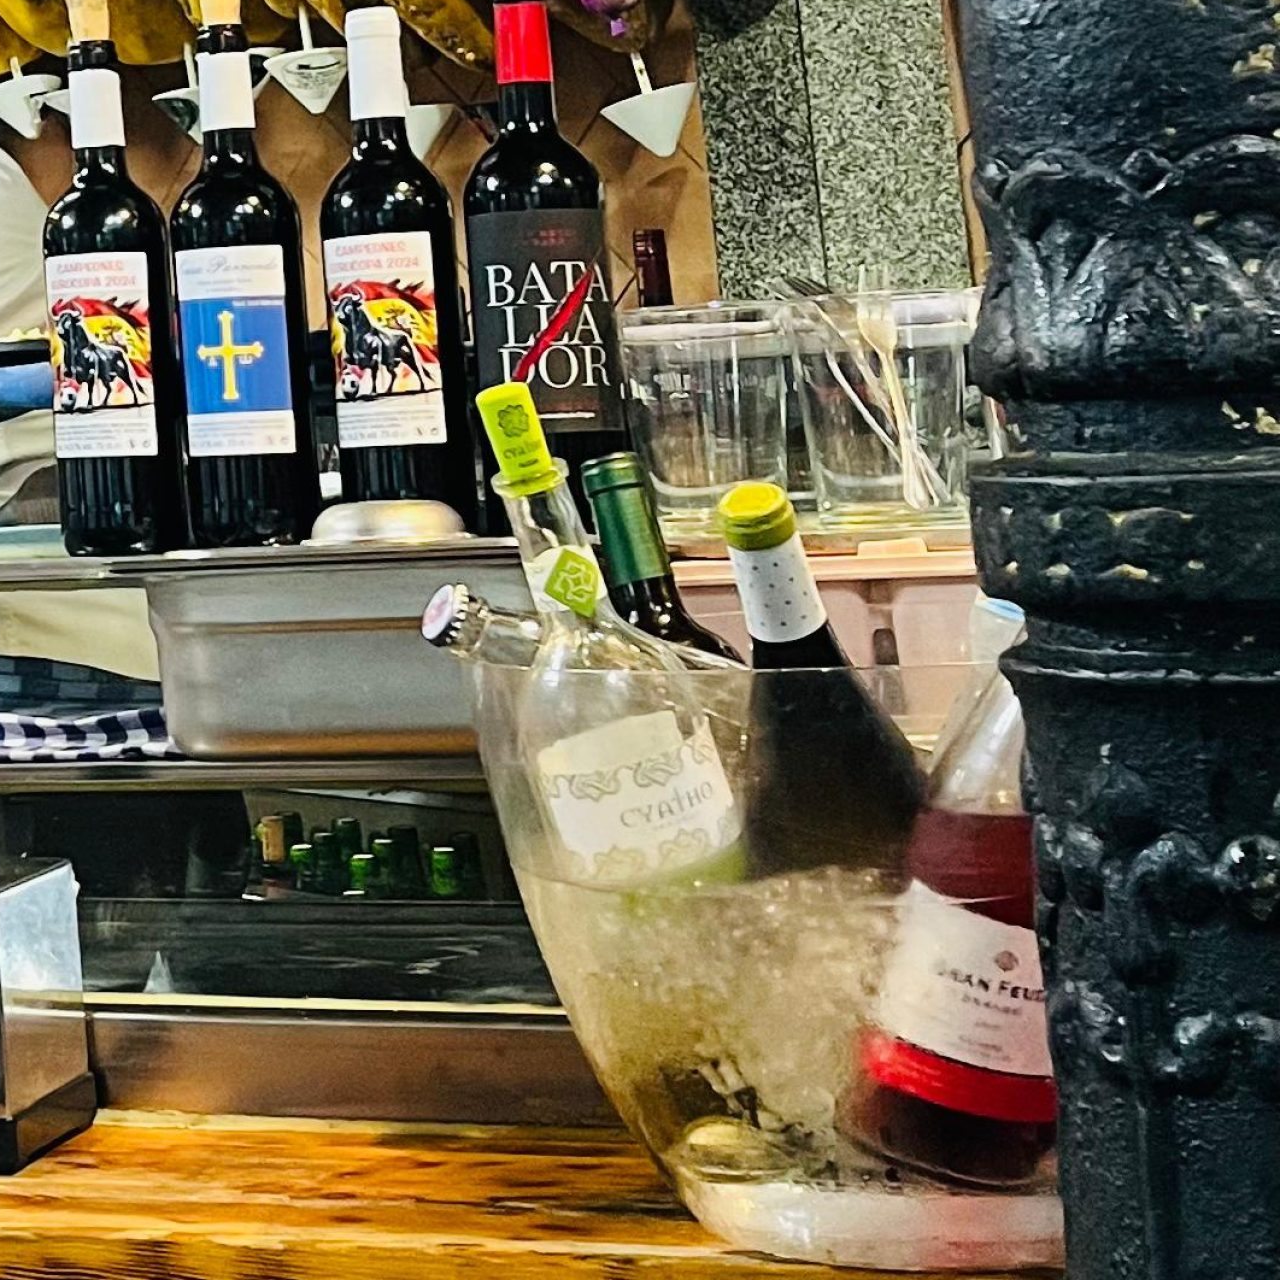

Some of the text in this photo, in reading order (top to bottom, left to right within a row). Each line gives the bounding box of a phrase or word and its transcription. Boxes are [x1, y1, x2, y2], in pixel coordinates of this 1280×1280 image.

[484, 260, 610, 307] BATA
[500, 302, 604, 349] LLA
[497, 343, 612, 389] DOR
[938, 968, 992, 993] RAN
